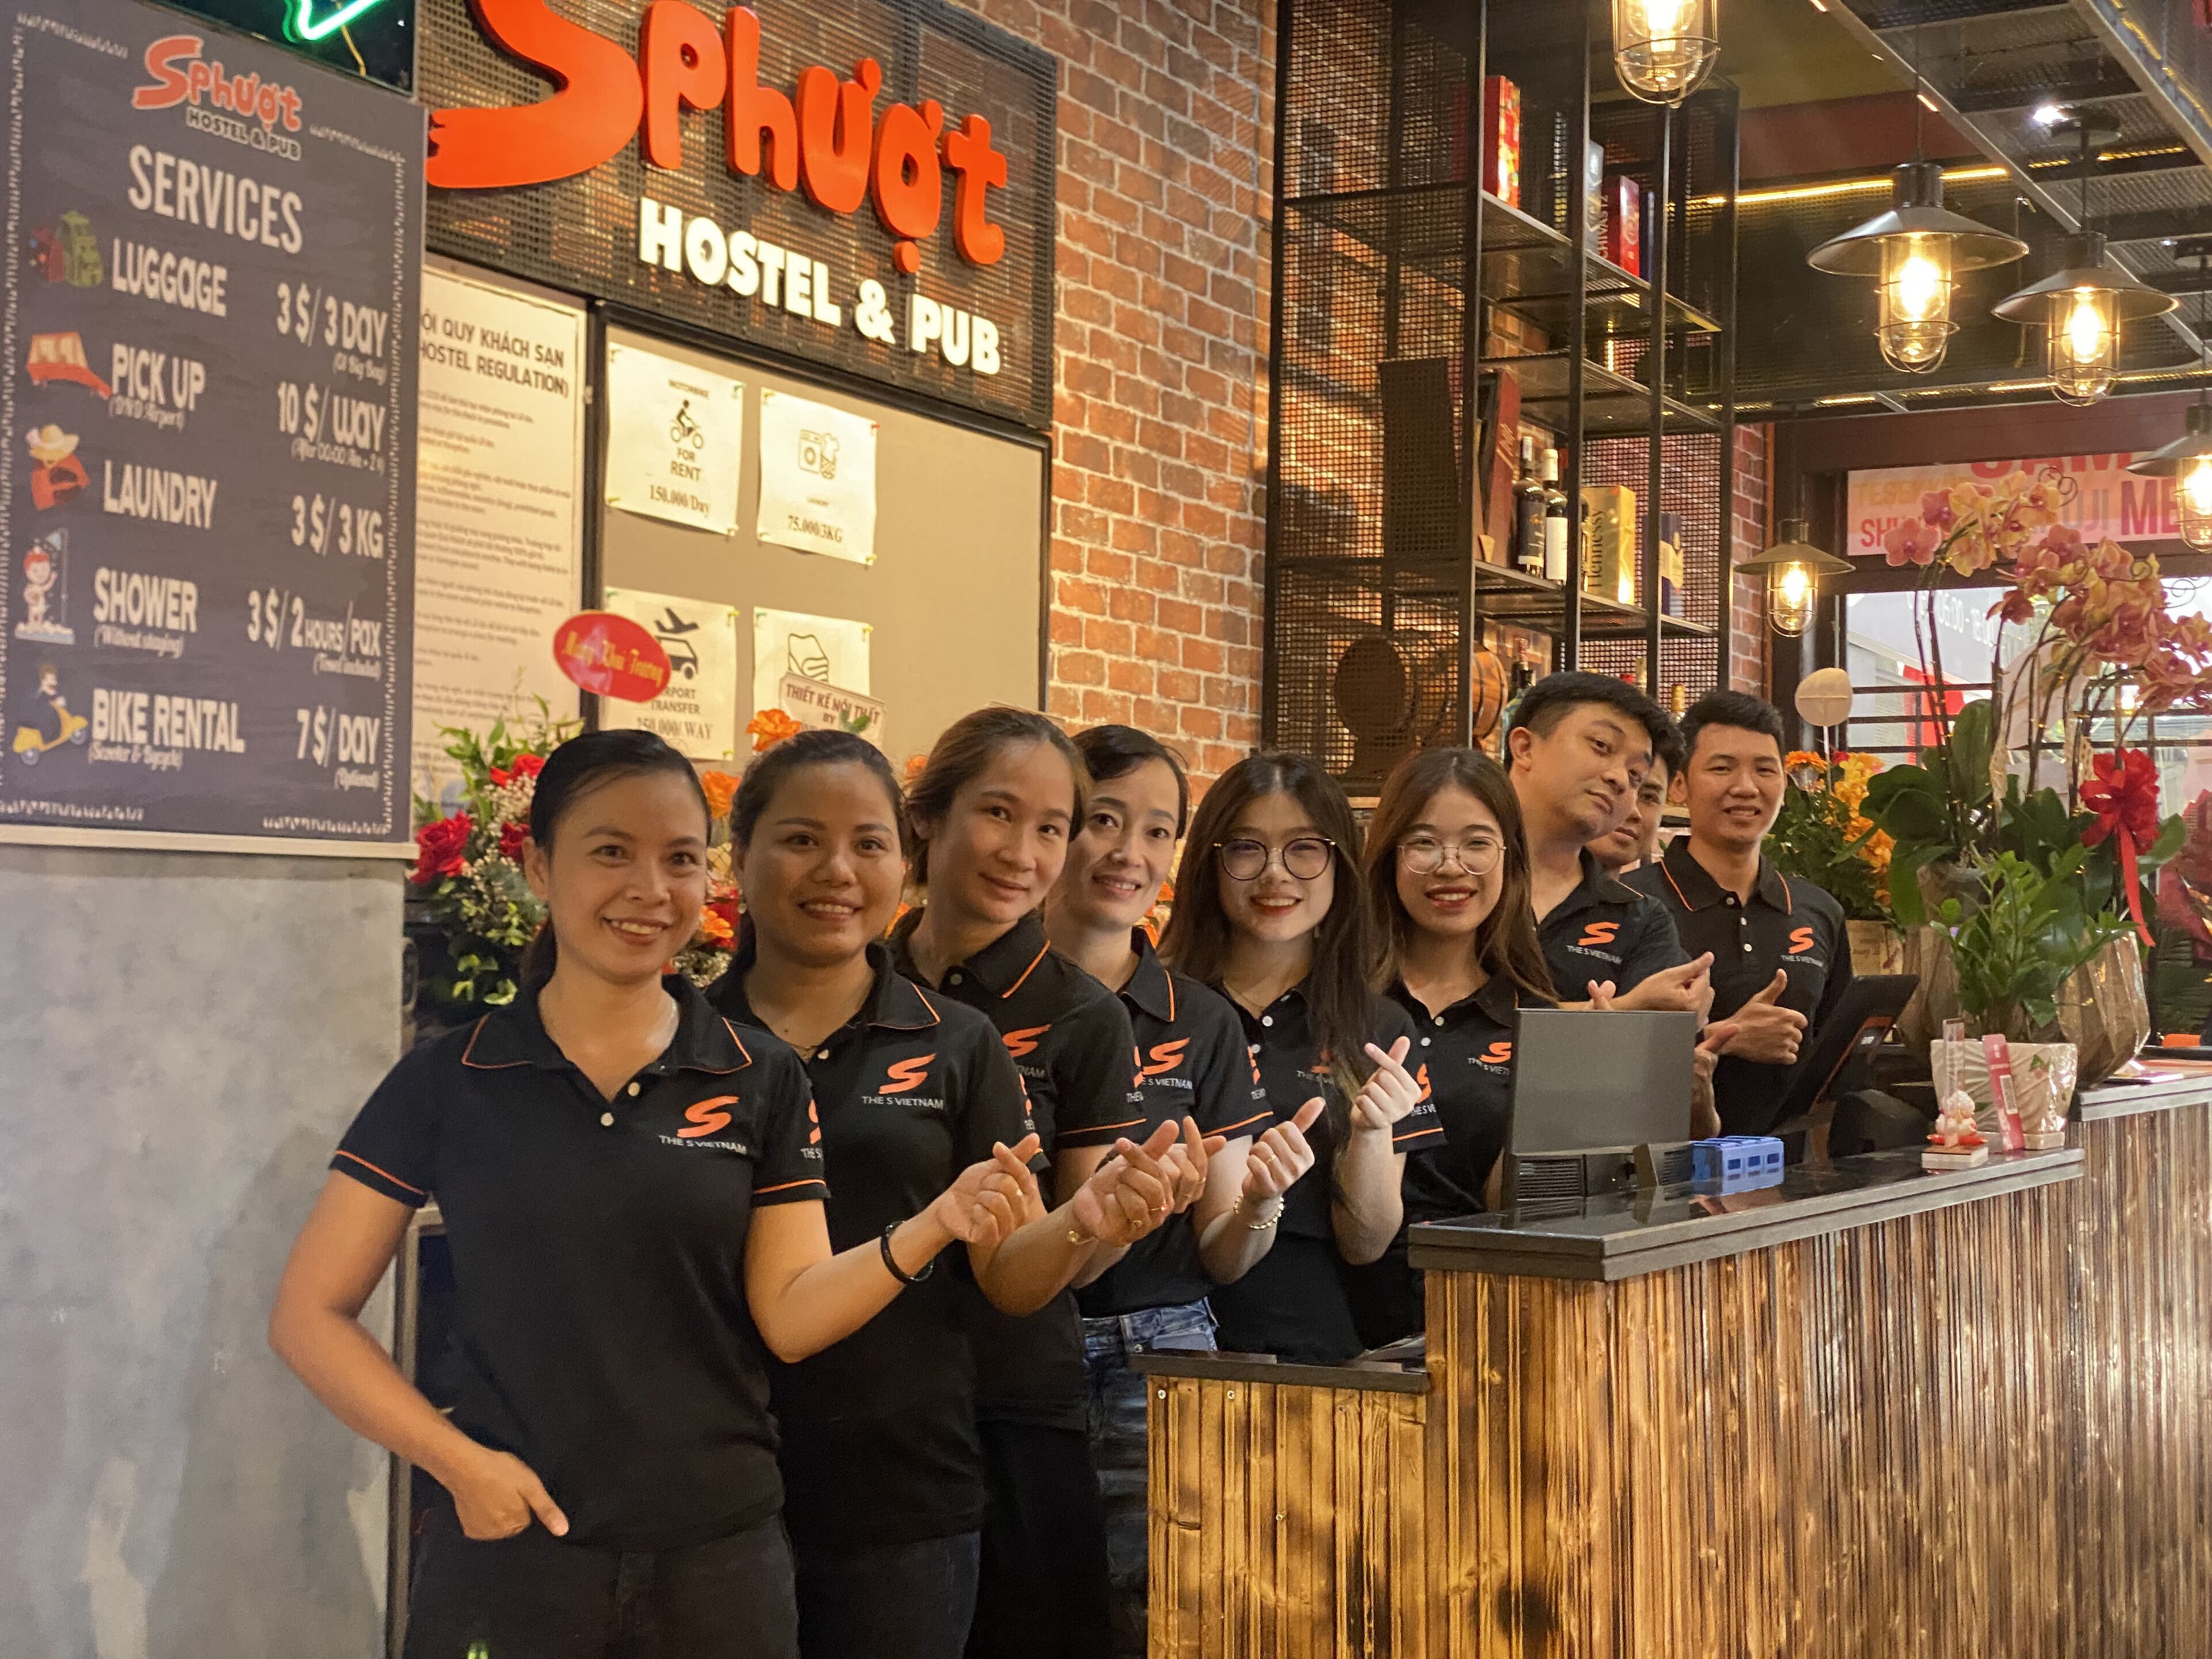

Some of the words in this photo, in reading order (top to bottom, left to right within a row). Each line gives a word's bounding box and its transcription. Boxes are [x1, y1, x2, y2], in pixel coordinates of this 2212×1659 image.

[185, 107, 247, 144] HOSTEL
[267, 130, 302, 162] PUB
[128, 145, 303, 254] SERVICES
[639, 196, 841, 328] HOSTEL
[854, 278, 896, 345] &
[911, 293, 1001, 377] PUB
[442, 318, 475, 343] QUY
[480, 328, 530, 359] KHÁCH
[534, 344, 565, 369] SẠN
[112, 343, 165, 405] PICK
[172, 354, 206, 411] UP
[476, 355, 569, 399] REGULATION)
[670, 460, 701, 482] RENT
[677, 447, 695, 462] FOR
[104, 460, 218, 530] LAUNDRY
[1588, 507, 1607, 588] Hennessy
[93, 567, 198, 633] SHOWER
[93, 688, 149, 745] BIKE
[153, 694, 247, 754] RENTAL
[652, 699, 700, 714] TRANSFER
[862, 1096, 884, 1105] THE
[893, 1097, 944, 1110] VIETNAM
[1154, 1078, 1193, 1090] VIETNAM
[658, 1135, 684, 1146] THE
[694, 1141, 747, 1156] VIETNAM
